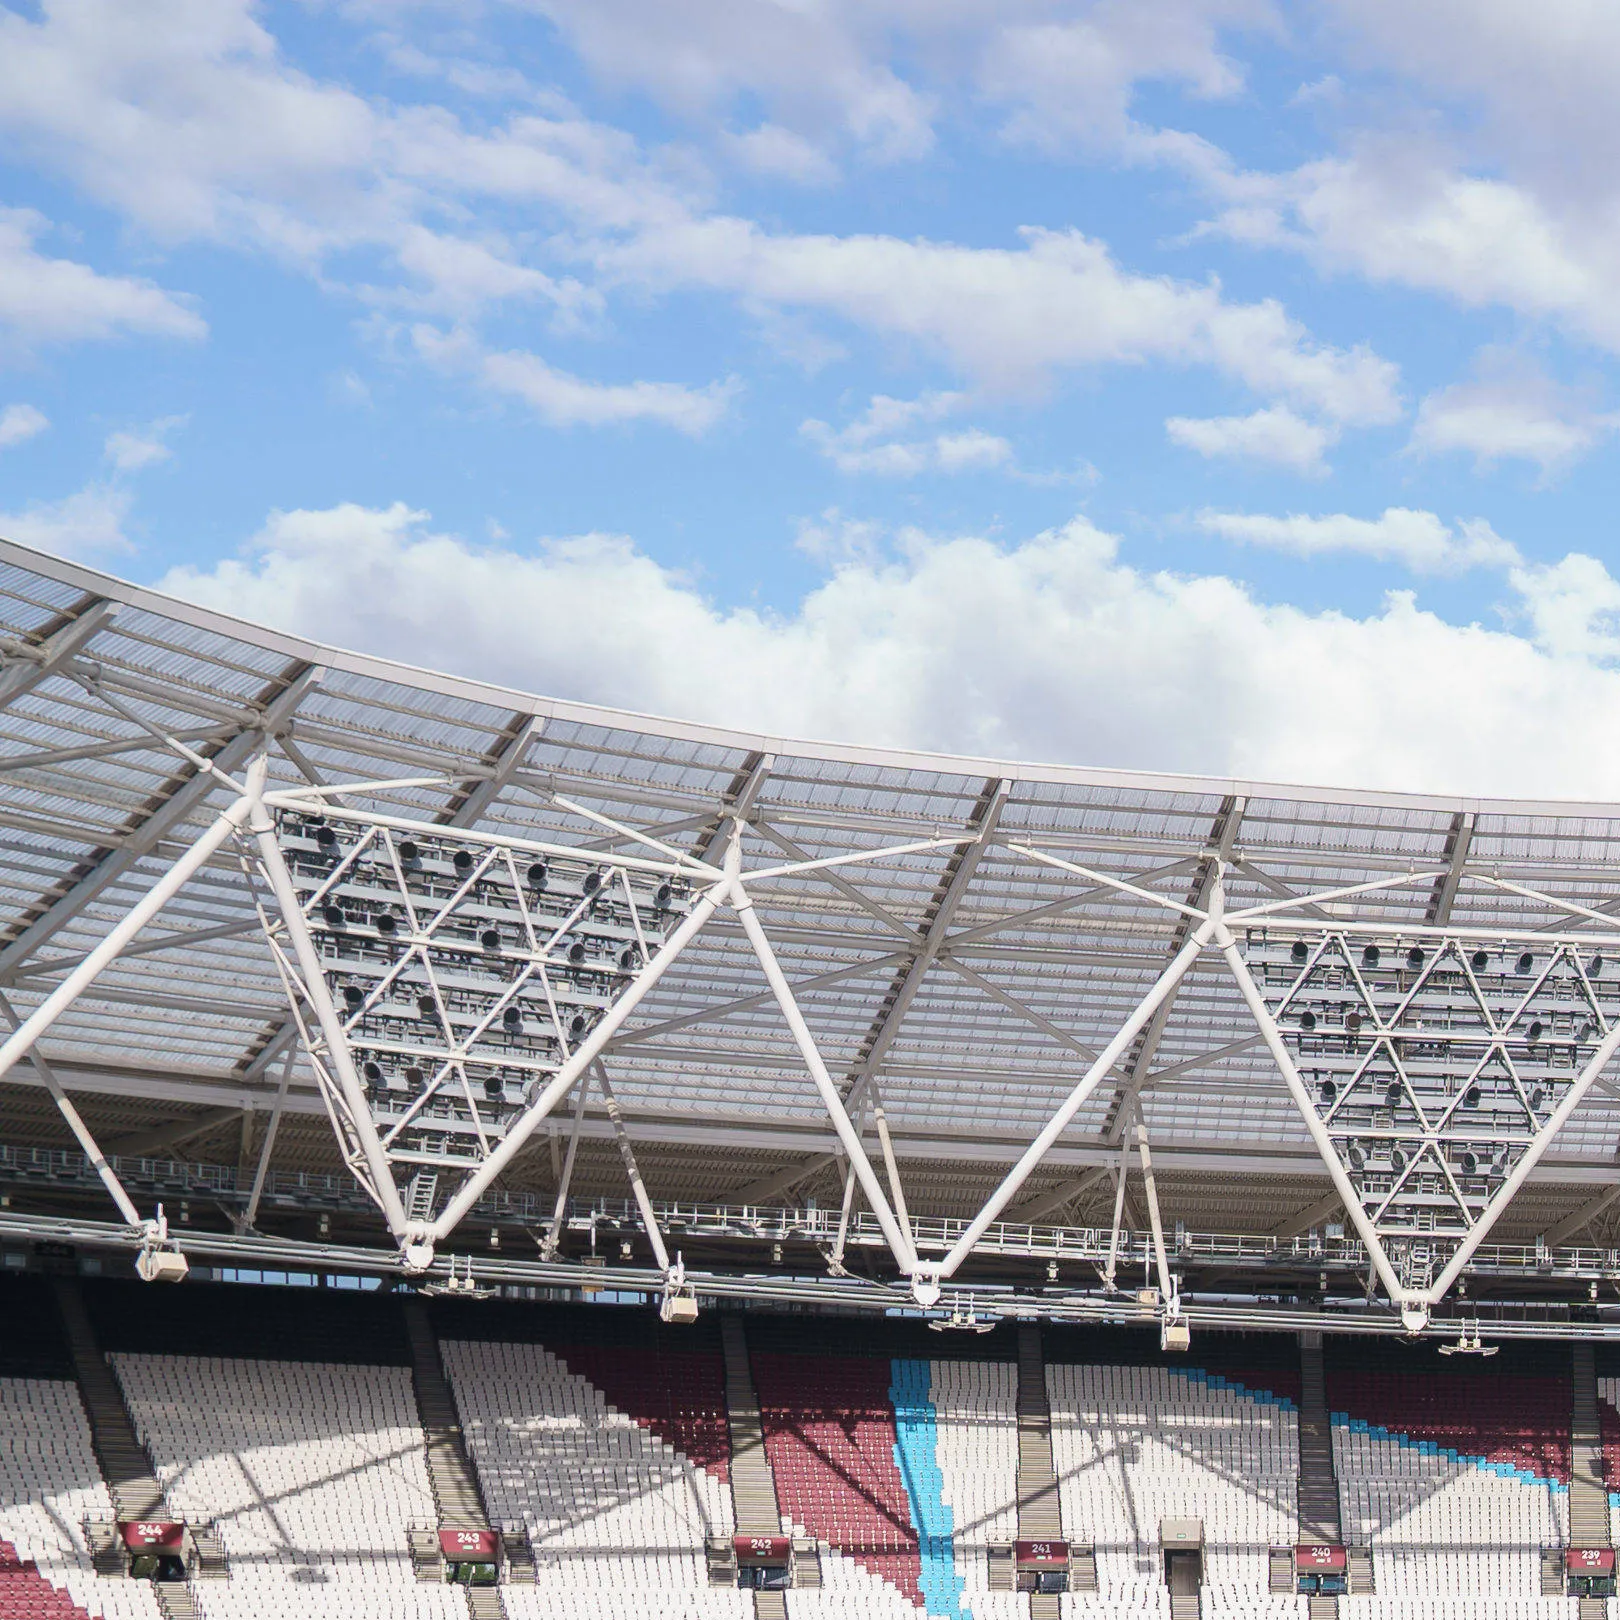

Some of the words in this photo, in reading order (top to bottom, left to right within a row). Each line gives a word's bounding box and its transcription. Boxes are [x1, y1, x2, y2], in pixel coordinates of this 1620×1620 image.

[138, 1525, 164, 1536] 244
[458, 1533, 480, 1543] 243
[751, 1539, 772, 1549] 242
[1032, 1544, 1052, 1553] 241
[1312, 1548, 1331, 1557] 240
[1582, 1550, 1600, 1559] 239
